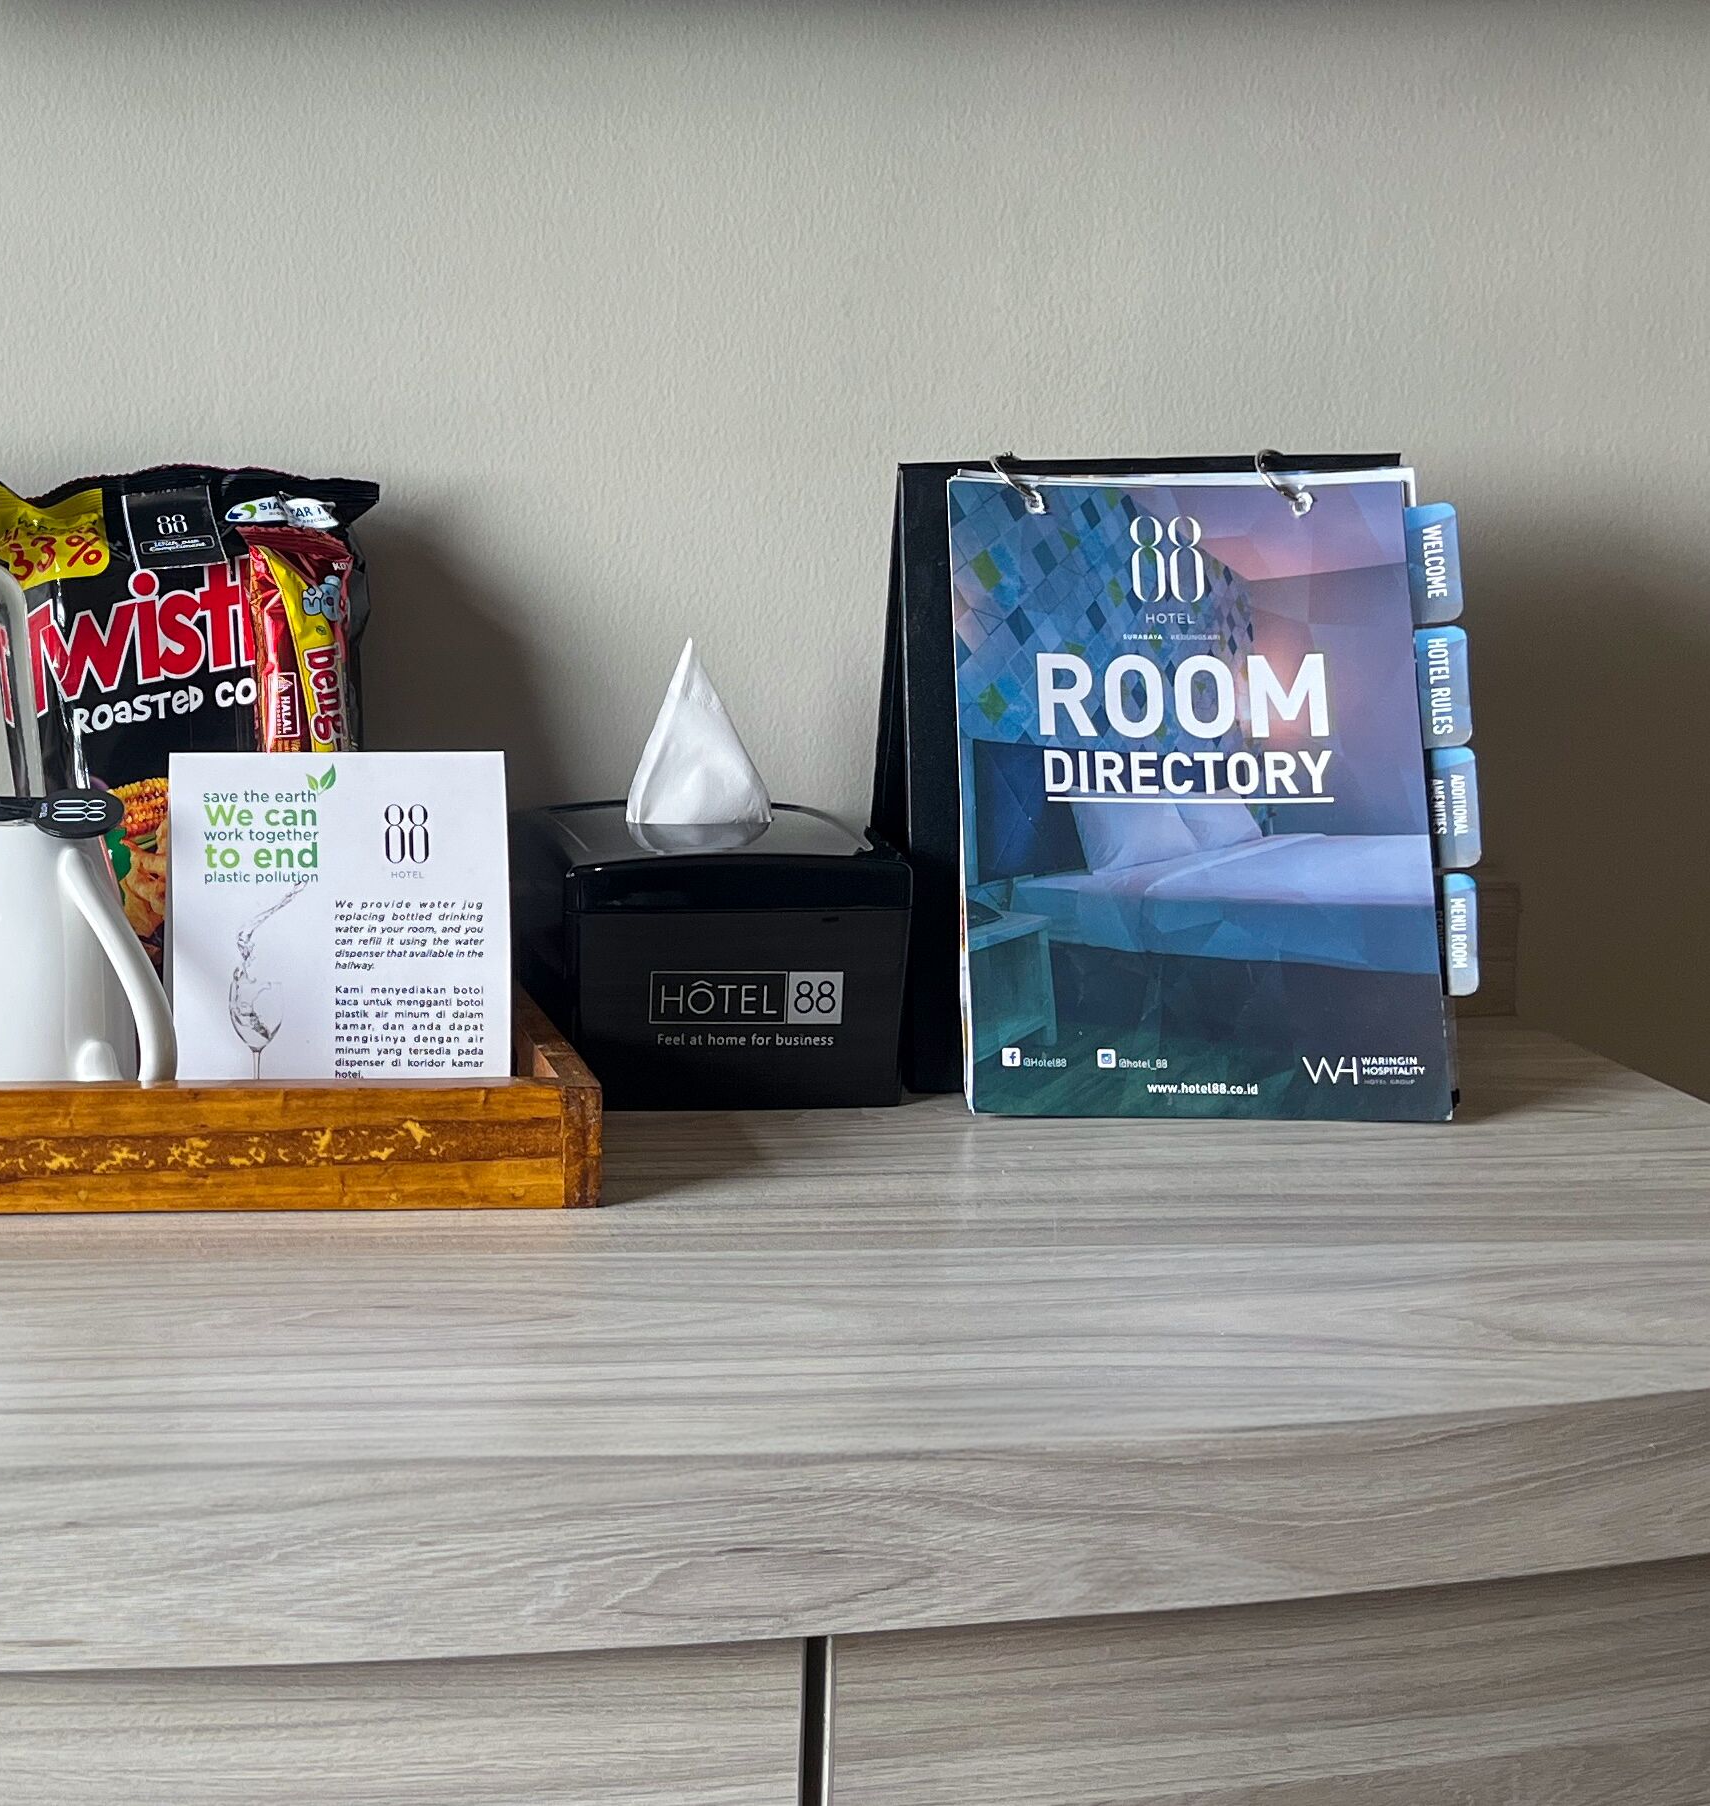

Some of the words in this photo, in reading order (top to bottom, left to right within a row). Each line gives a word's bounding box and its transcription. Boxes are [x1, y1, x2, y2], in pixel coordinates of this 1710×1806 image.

[157, 514, 188, 535] 88
[9, 533, 103, 581] 33%
[1129, 515, 1205, 603] 88
[1422, 524, 1447, 599] WELCOME
[1146, 613, 1195, 624] HOTEL
[1427, 638, 1450, 685] HOTEL
[215, 678, 257, 708] CO
[1036, 652, 1330, 739] ROOM
[1430, 687, 1454, 736] RULES
[1043, 749, 1333, 795] DIRECTORY
[202, 792, 239, 803] save
[243, 790, 269, 803] the
[275, 790, 317, 803] earth
[52, 799, 107, 822] 88
[1432, 778, 1447, 835] AMENITIES
[1450, 774, 1468, 836] ADDITIONAL
[204, 804, 254, 826] We
[264, 808, 318, 827] can
[204, 829, 244, 841] work
[248, 829, 320, 844] together
[384, 803, 430, 864] 88
[205, 843, 240, 868] to
[253, 843, 319, 869] end
[204, 870, 250, 885] plastic
[255, 870, 319, 884] pollution
[390, 871, 425, 879] HOTEL
[335, 900, 353, 908] We
[360, 899, 411, 910] provide
[419, 901, 456, 910] water
[462, 900, 483, 910] jug
[334, 912, 385, 922] replacing
[392, 912, 432, 921] bottled
[438, 912, 483, 922] drinking
[1450, 898, 1467, 933] MENU
[335, 924, 364, 933] water
[367, 924, 377, 933] in
[379, 924, 404, 935] your
[407, 926, 437, 934] room,
[441, 925, 461, 933] and
[464, 926, 484, 935] you
[335, 936, 353, 945] can
[358, 937, 382, 945] refill
[387, 936, 394, 945] it
[400, 937, 427, 947] using
[433, 937, 449, 945] the
[455, 938, 484, 946] water
[335, 949, 385, 959] dispenser
[387, 949, 407, 957] that
[408, 949, 454, 958] available
[455, 949, 465, 958] in
[467, 949, 484, 958] the
[1451, 934, 1468, 969] ROOM
[335, 961, 374, 971] hallway.
[334, 985, 363, 994] Kami
[371, 985, 446, 995] menyediakan
[453, 985, 483, 994] botol
[334, 998, 358, 1008] kaca
[363, 998, 392, 1006] untuk
[397, 998, 452, 1008] mengganti
[457, 998, 483, 1007] botol
[660, 980, 778, 1015] HÔTEL
[793, 980, 837, 1014] 88
[334, 1010, 369, 1019] plastik
[375, 1010, 389, 1018] air
[395, 1010, 429, 1018] minum
[436, 1010, 446, 1018] di
[452, 1010, 483, 1019] dalam
[334, 1022, 374, 1032] kamar,
[382, 1022, 404, 1031] dan
[410, 1022, 441, 1031] anda
[449, 1022, 484, 1032] dapat
[334, 1034, 406, 1045] mengisinya
[413, 1034, 459, 1044] dengan
[468, 1034, 484, 1043] air
[657, 1033, 686, 1046] Feel
[689, 1034, 703, 1046] at
[707, 1033, 747, 1046] home
[751, 1033, 772, 1046] for
[775, 1033, 834, 1046] business
[334, 1047, 370, 1056] minum
[377, 1048, 402, 1056] yang
[409, 1047, 451, 1055] tersedia
[458, 1047, 483, 1056] pada
[334, 1058, 385, 1068] dispenser
[391, 1058, 401, 1067] di
[408, 1058, 445, 1067] koridor
[452, 1059, 484, 1067] kamar
[1023, 1058, 1067, 1068] @Hotel88
[1118, 1058, 1168, 1070] @hotel_88
[1361, 1057, 1418, 1065] WARINGIN
[334, 1069, 365, 1078] hotel.
[1362, 1066, 1425, 1075] HOSPITALITY
[1147, 1082, 1259, 1095] www.hotel88.co.id
